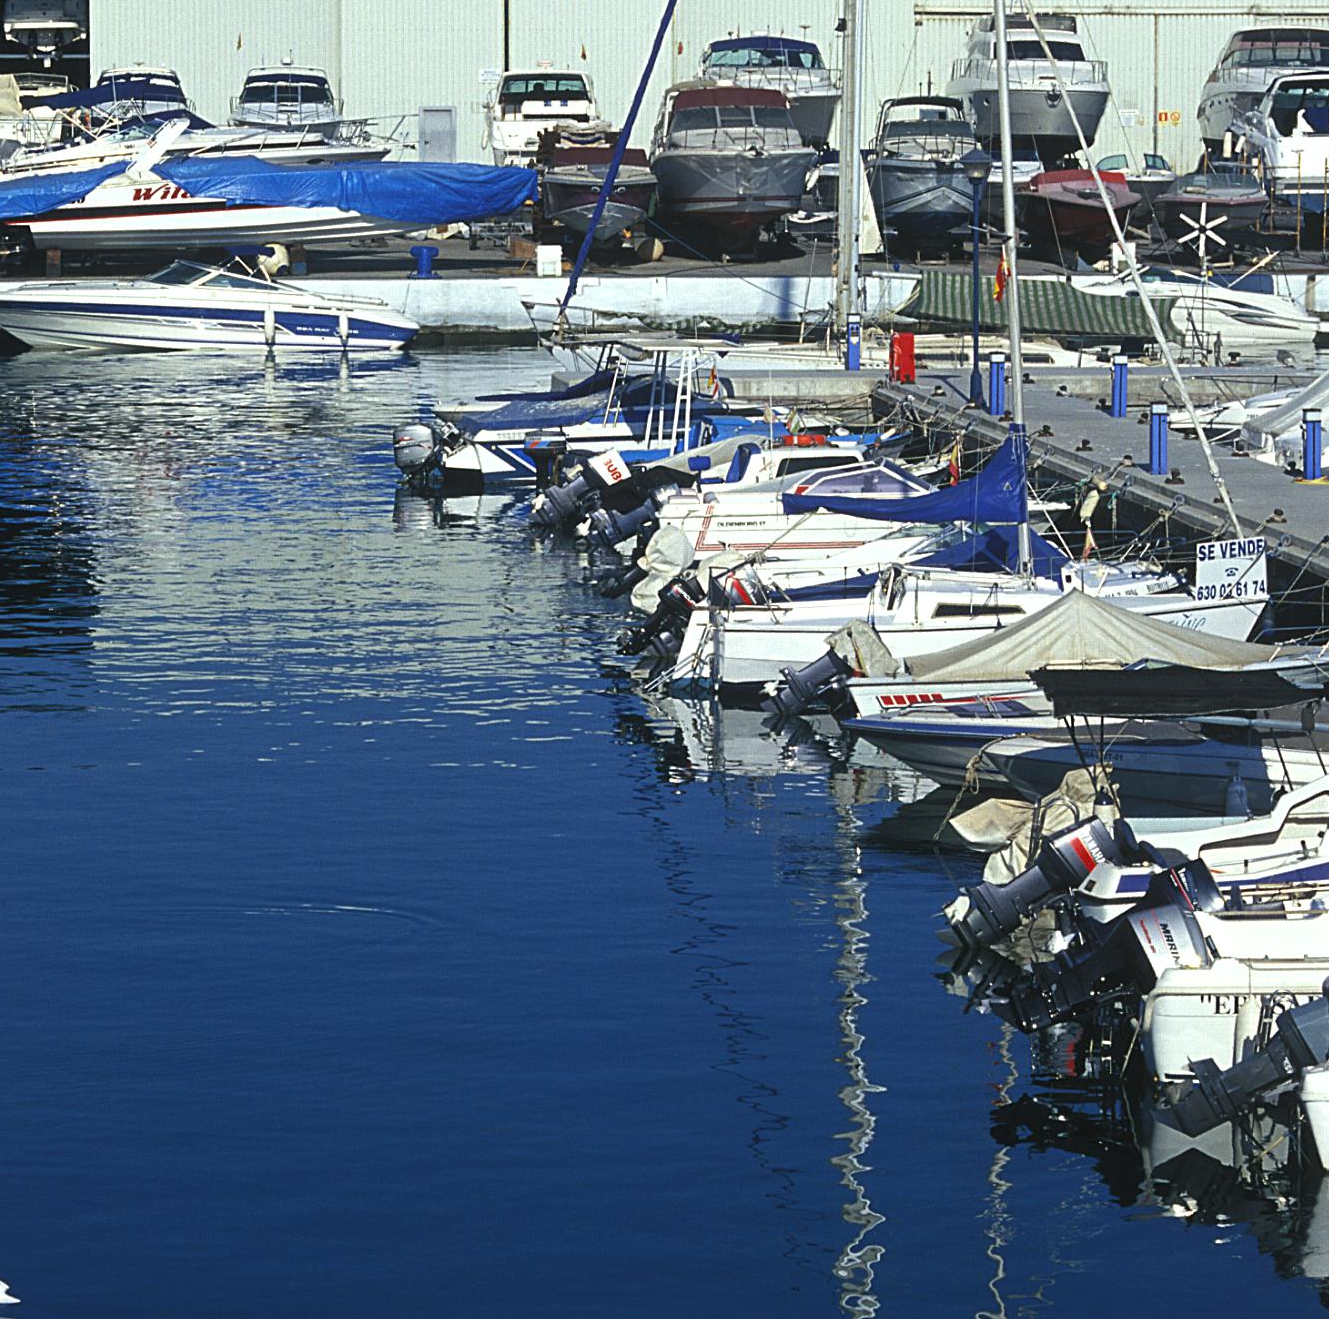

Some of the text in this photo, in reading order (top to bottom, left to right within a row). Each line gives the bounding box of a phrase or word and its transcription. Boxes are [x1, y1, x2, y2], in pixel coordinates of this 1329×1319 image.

[1198, 539, 1264, 561] SE VENDE
[1197, 585, 1216, 600] 630
[1236, 581, 1248, 597] 61
[1253, 580, 1265, 594] 74
